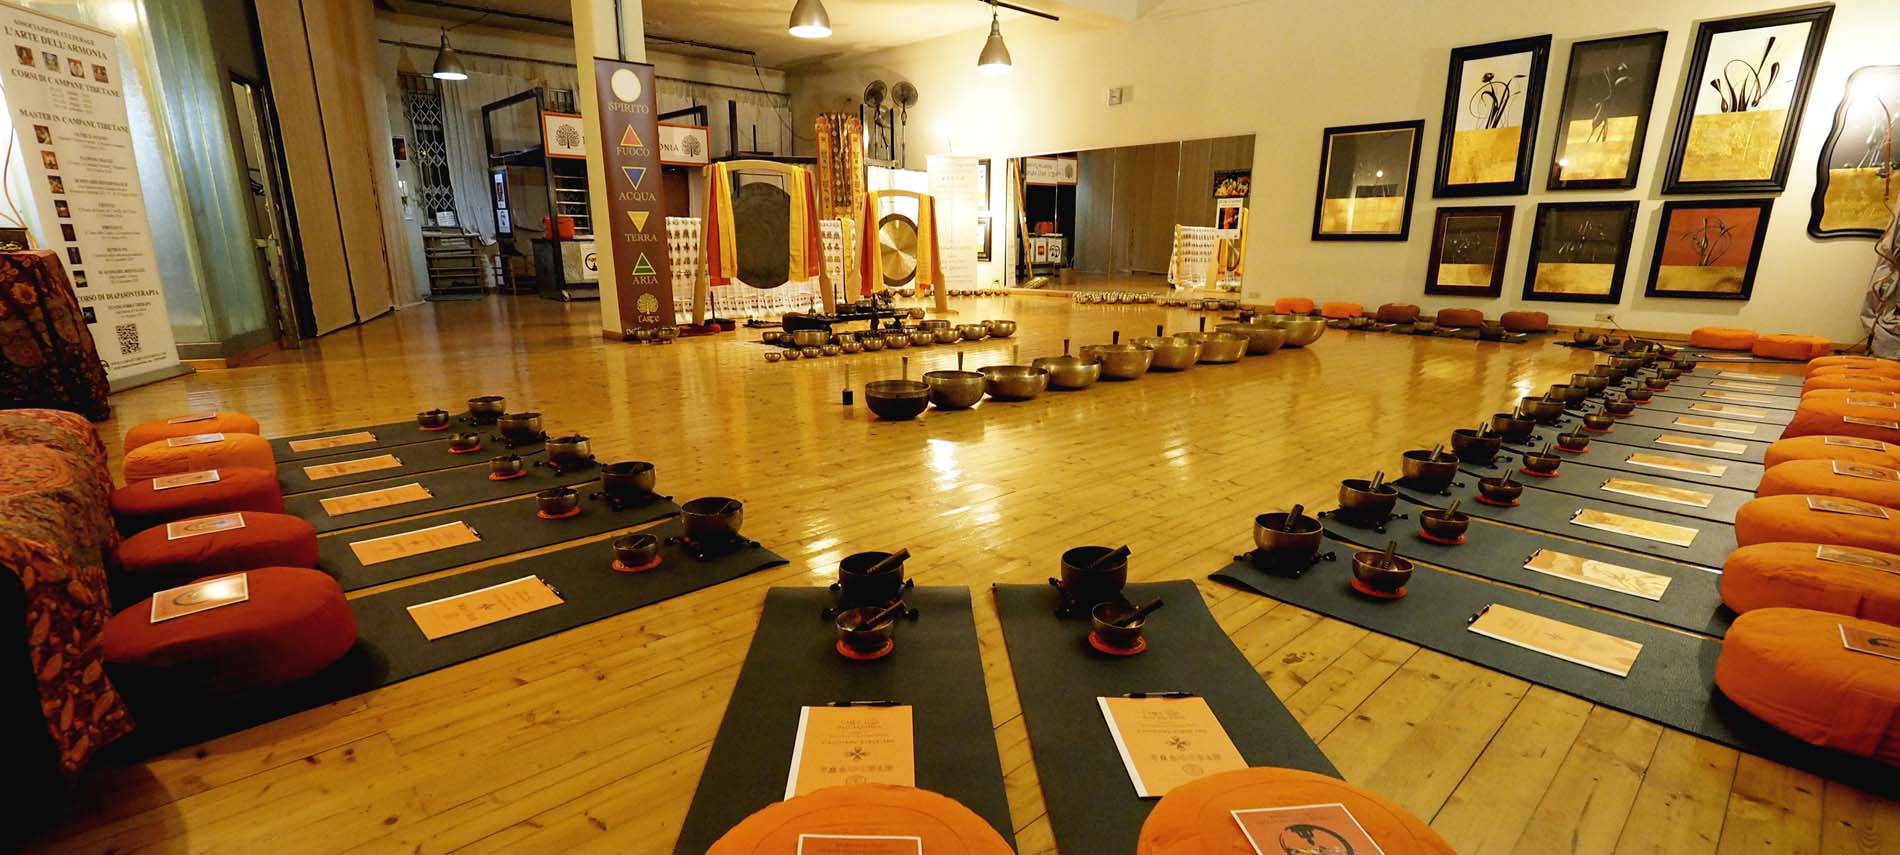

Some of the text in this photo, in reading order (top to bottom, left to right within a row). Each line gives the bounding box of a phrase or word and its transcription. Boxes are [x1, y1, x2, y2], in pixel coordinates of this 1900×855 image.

[4, 26, 108, 60] L'ARTE DELL'ARMONIA
[11, 68, 120, 98] CORSI DI CAMPANE TIBETANE
[607, 101, 650, 114] SPIRITO
[19, 108, 52, 121] MASTER
[62, 116, 97, 128] CAMPANE
[616, 146, 651, 157] FUOCO
[618, 191, 657, 202] ACQUA
[625, 233, 658, 242] TERRA
[632, 275, 659, 285] ARIA
[98, 293, 105, 301] DI
